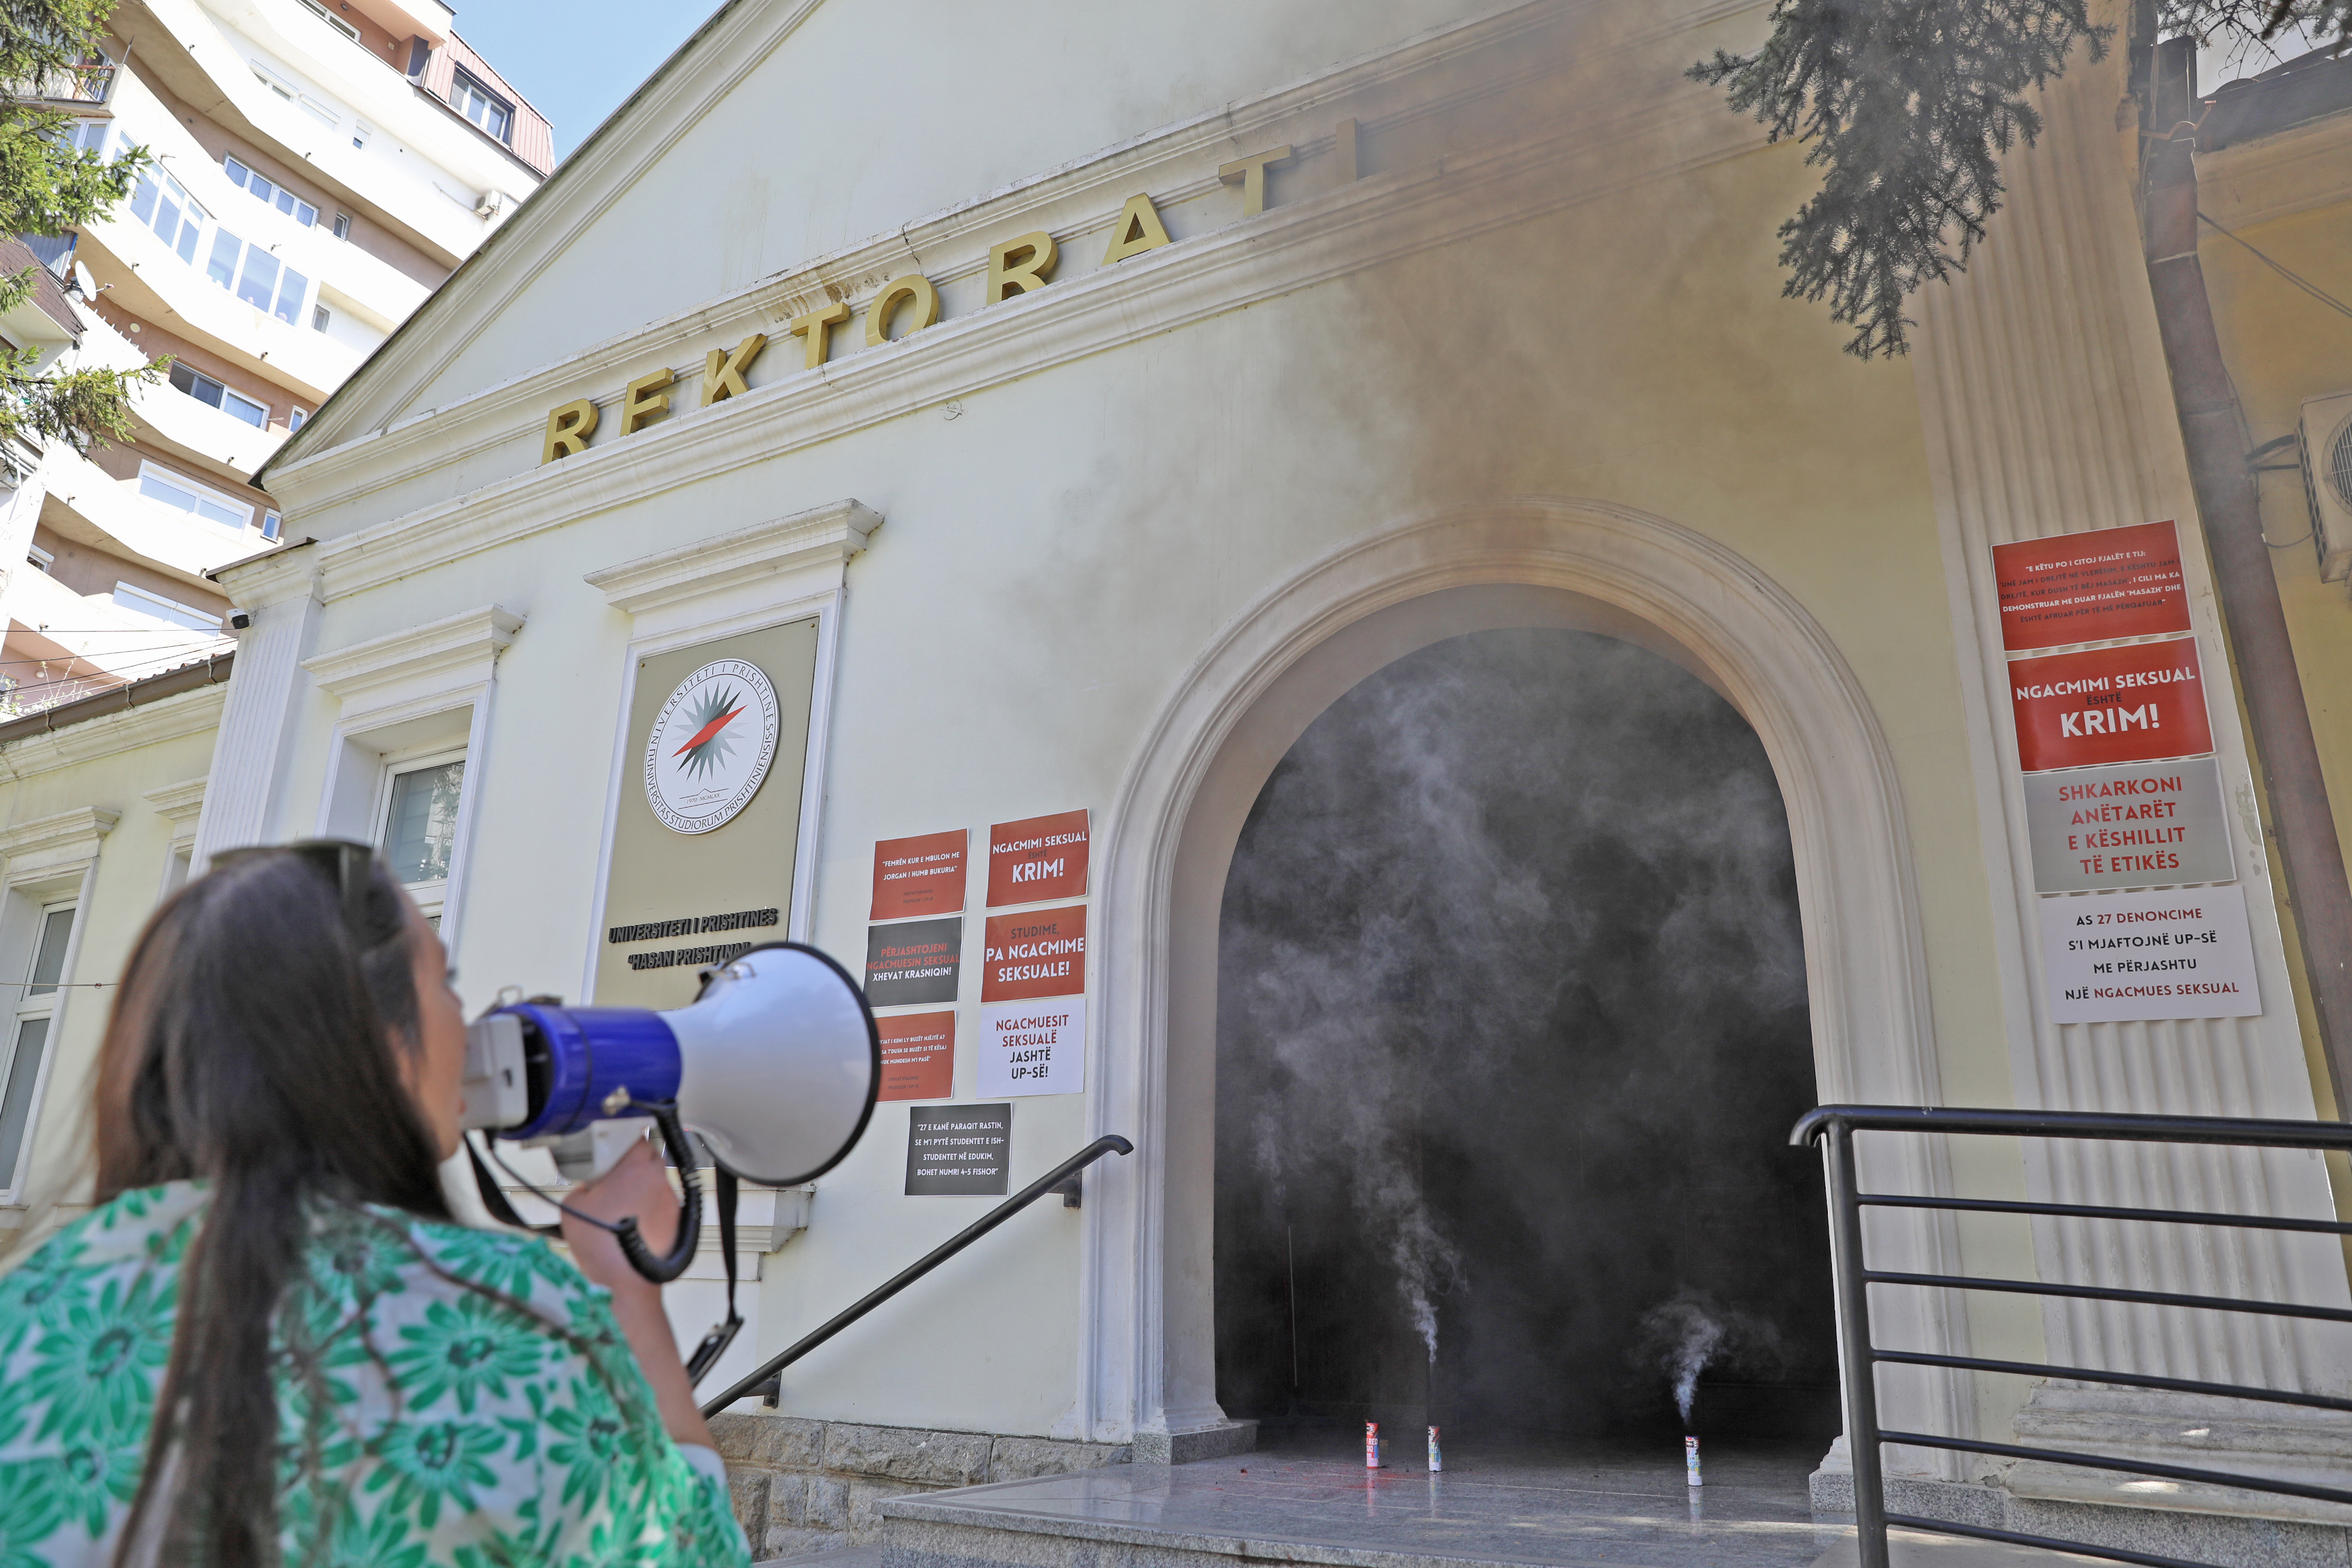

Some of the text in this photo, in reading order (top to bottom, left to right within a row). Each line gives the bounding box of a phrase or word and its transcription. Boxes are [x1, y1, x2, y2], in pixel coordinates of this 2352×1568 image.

[2074, 557, 2096, 565] CITOJ
[2099, 553, 2124, 562] FJALËT
[2041, 573, 2066, 582] DREJTË
[2003, 600, 2060, 612] DEMONSTRUAR
[2074, 595, 2096, 603] DUAR
[2098, 591, 2125, 600] FJALËN
[2021, 614, 2042, 622] ËSHTË
[2045, 611, 2073, 620] AFRUAR
[2016, 667, 2195, 700] NGACMIMI SEKSUAL
[2086, 692, 2122, 705] ËSHTË
[649, 666, 715, 756] UNIVERSITETI
[722, 664, 726, 672] I
[2060, 703, 2159, 738] KRIM!
[647, 759, 671, 820] UNIVERSITAS
[669, 812, 723, 830] STUDIORUM
[699, 793, 720, 801] MCMLXX
[2059, 777, 2182, 801] SHKARKONI
[2071, 799, 2176, 825] ANËTARËT
[993, 831, 1087, 854] NGACMIMI SEKSUAL
[2068, 827, 2185, 850] E KËSHILLIT
[925, 853, 949, 862] MBULON
[1028, 849, 1047, 859] ËSHTË
[2080, 850, 2179, 874] TË ETIKËS
[884, 872, 906, 880] JORGAN
[1012, 858, 1064, 883] KRIM!
[2076, 908, 2202, 926] AS 27 DENONCIME
[609, 918, 691, 944] UNIVERSITETI
[692, 918, 699, 934] I
[1011, 924, 1060, 939] STUDIME,
[2069, 930, 2217, 950] S'I MJAFTOJNË UP-SË
[881, 943, 947, 957] PËRJASHTOJENI
[986, 937, 1084, 962] PA NGACMIME
[867, 954, 959, 971] NGACMUESIN SEKSUAL
[2093, 958, 2197, 974] ME PËRJASHTU
[873, 967, 952, 982] XHEVAT KRASNIQIN!
[998, 961, 1070, 982] SEKSUALE!
[2065, 982, 2239, 1000] NJË NGACMUES SEKSUAL
[996, 1014, 1069, 1031] NGACMUESIT
[1002, 1030, 1056, 1047] SEKSUALË
[1010, 1046, 1051, 1063] JASHTË
[1012, 1063, 1048, 1079] UP-SË!
[933, 1122, 949, 1131] KANË
[934, 1137, 948, 1145] PYTË
